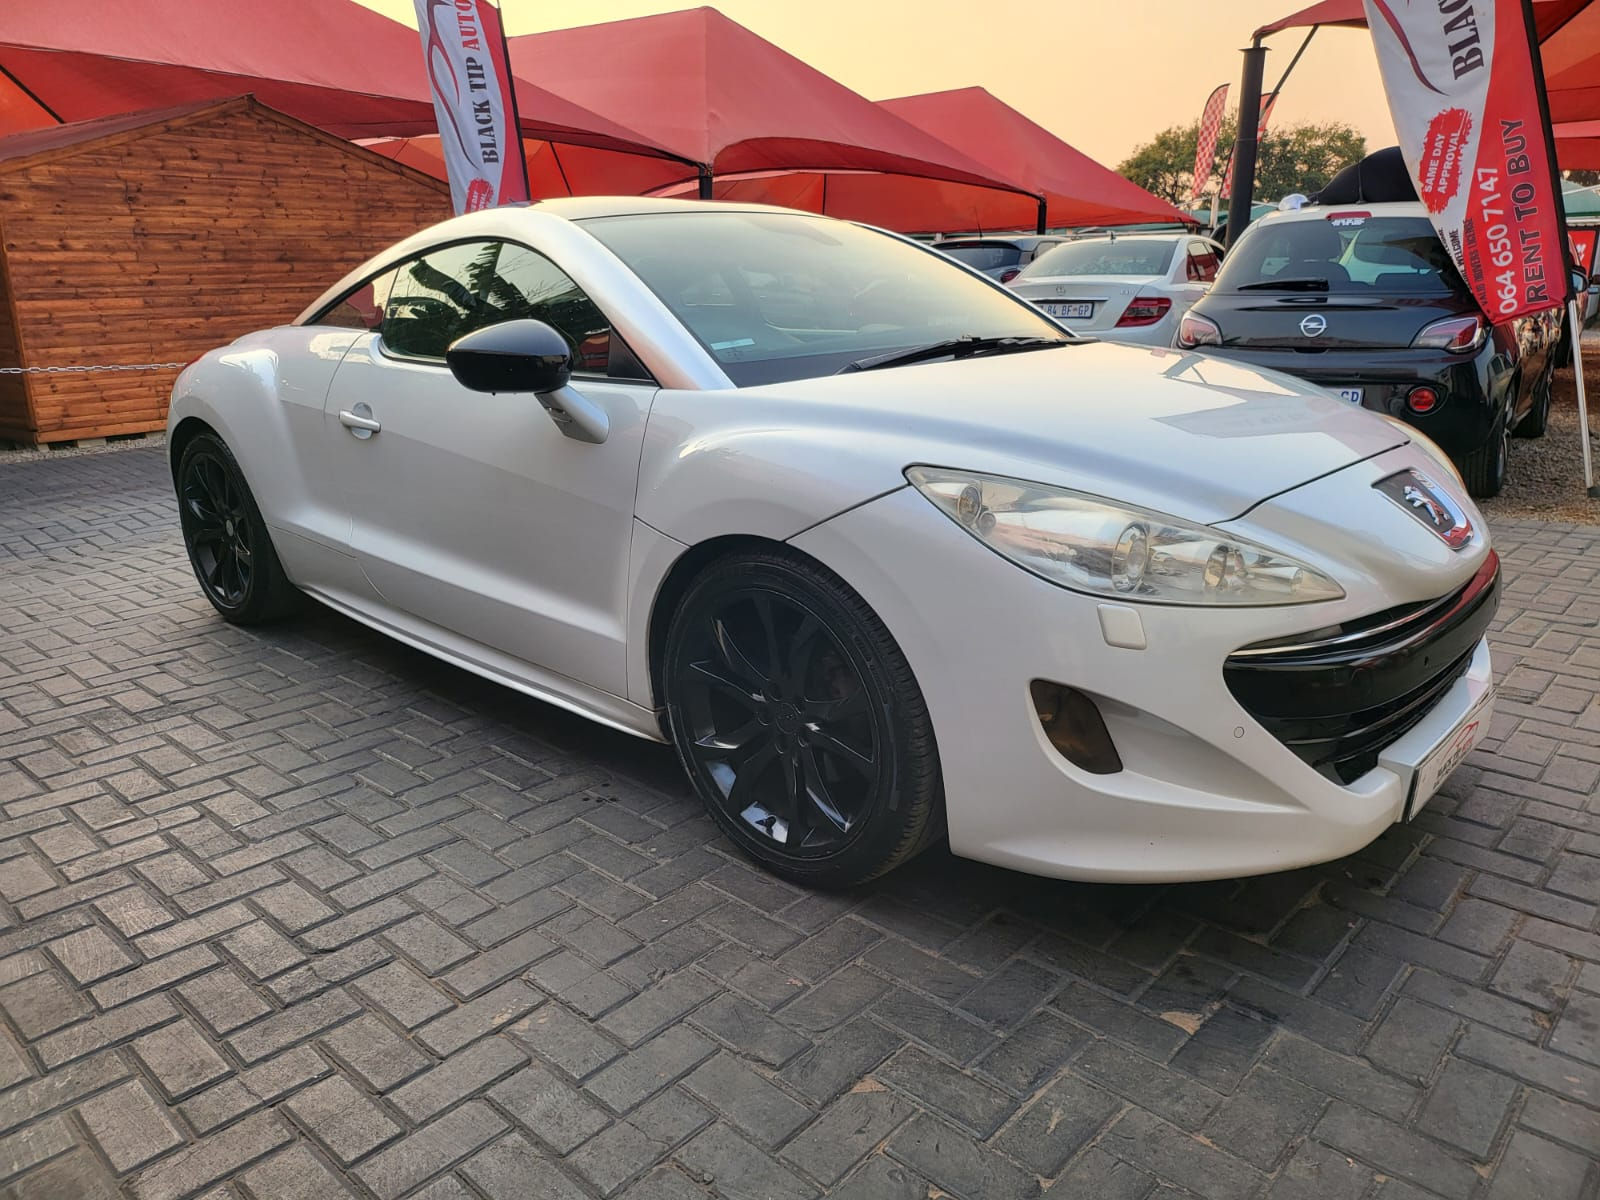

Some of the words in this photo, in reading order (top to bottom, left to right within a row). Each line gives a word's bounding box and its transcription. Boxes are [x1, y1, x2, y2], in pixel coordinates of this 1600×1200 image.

[466, 57, 486, 92] TIP
[472, 100, 499, 164] BLACK
[1500, 119, 1531, 176] BUY
[1425, 159, 1439, 193] SAME
[1433, 133, 1446, 157] DAY
[1438, 132, 1459, 194] APPROVAL
[1477, 167, 1505, 222] 7147
[1513, 183, 1537, 221] TO
[1487, 223, 1513, 267] 650
[1522, 230, 1549, 303] RENT
[1078, 304, 1090, 315] GP
[1496, 271, 1518, 314] 064
